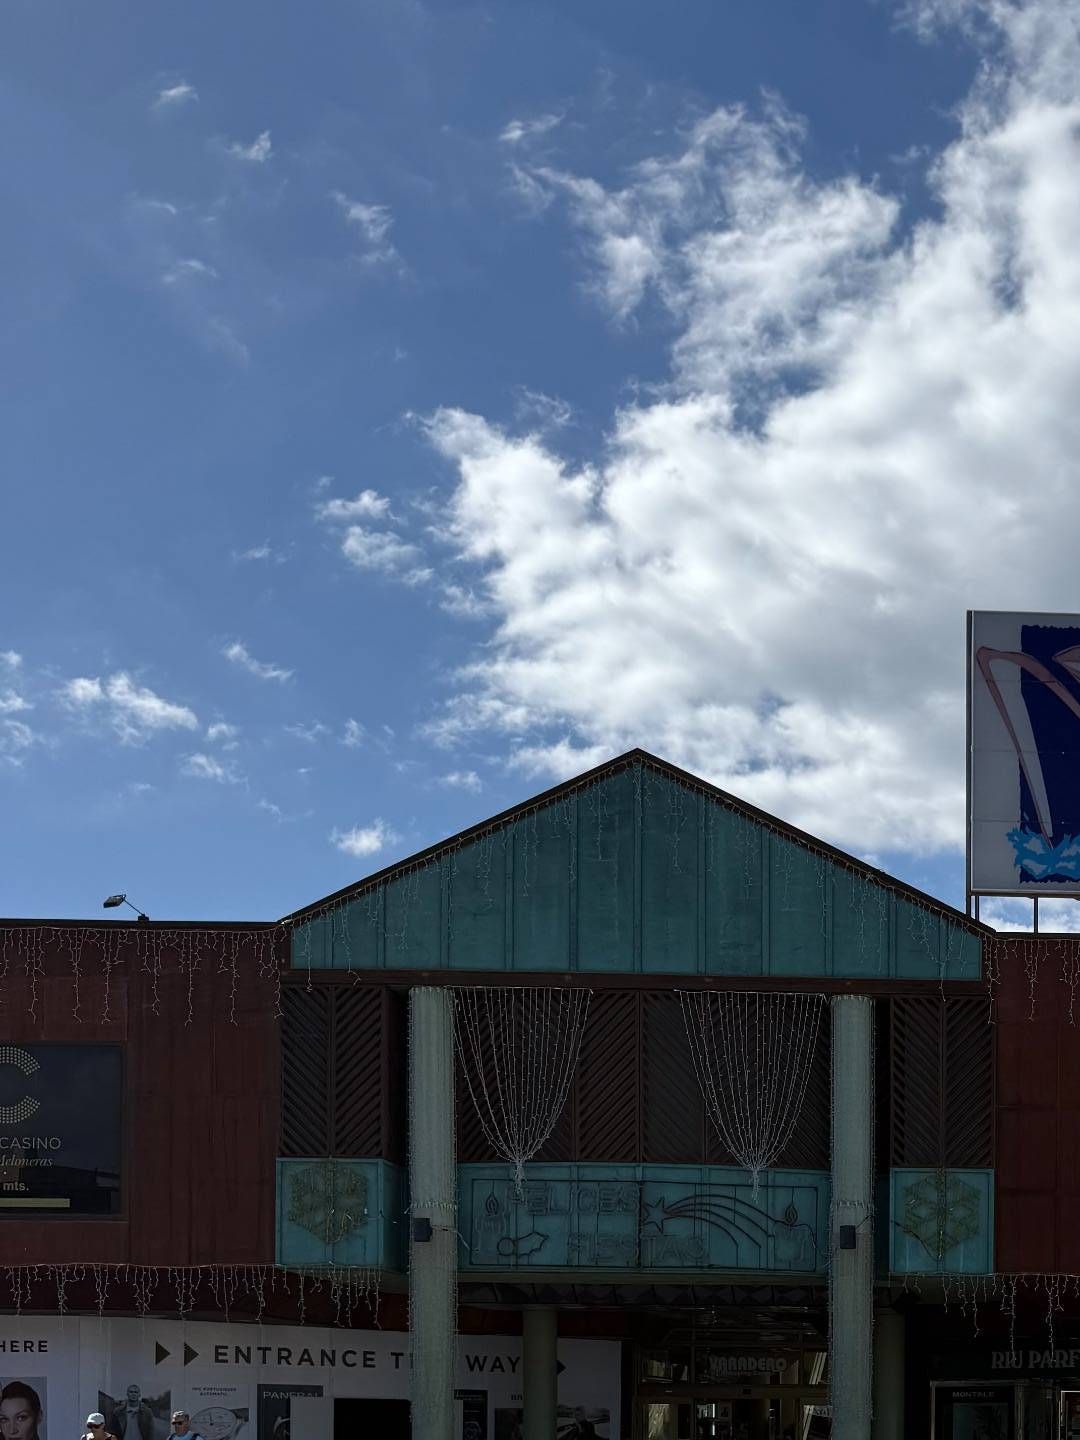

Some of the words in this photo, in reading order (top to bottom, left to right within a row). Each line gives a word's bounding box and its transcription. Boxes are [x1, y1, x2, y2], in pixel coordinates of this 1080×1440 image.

[0, 1137, 62, 1150] CASINO
[0, 1154, 54, 1167] eloneras
[3, 1181, 30, 1191] mts.
[214, 1345, 376, 1369] ENTRANCE
[465, 1354, 520, 1373] WAY
[991, 1349, 1023, 1369] RIU
